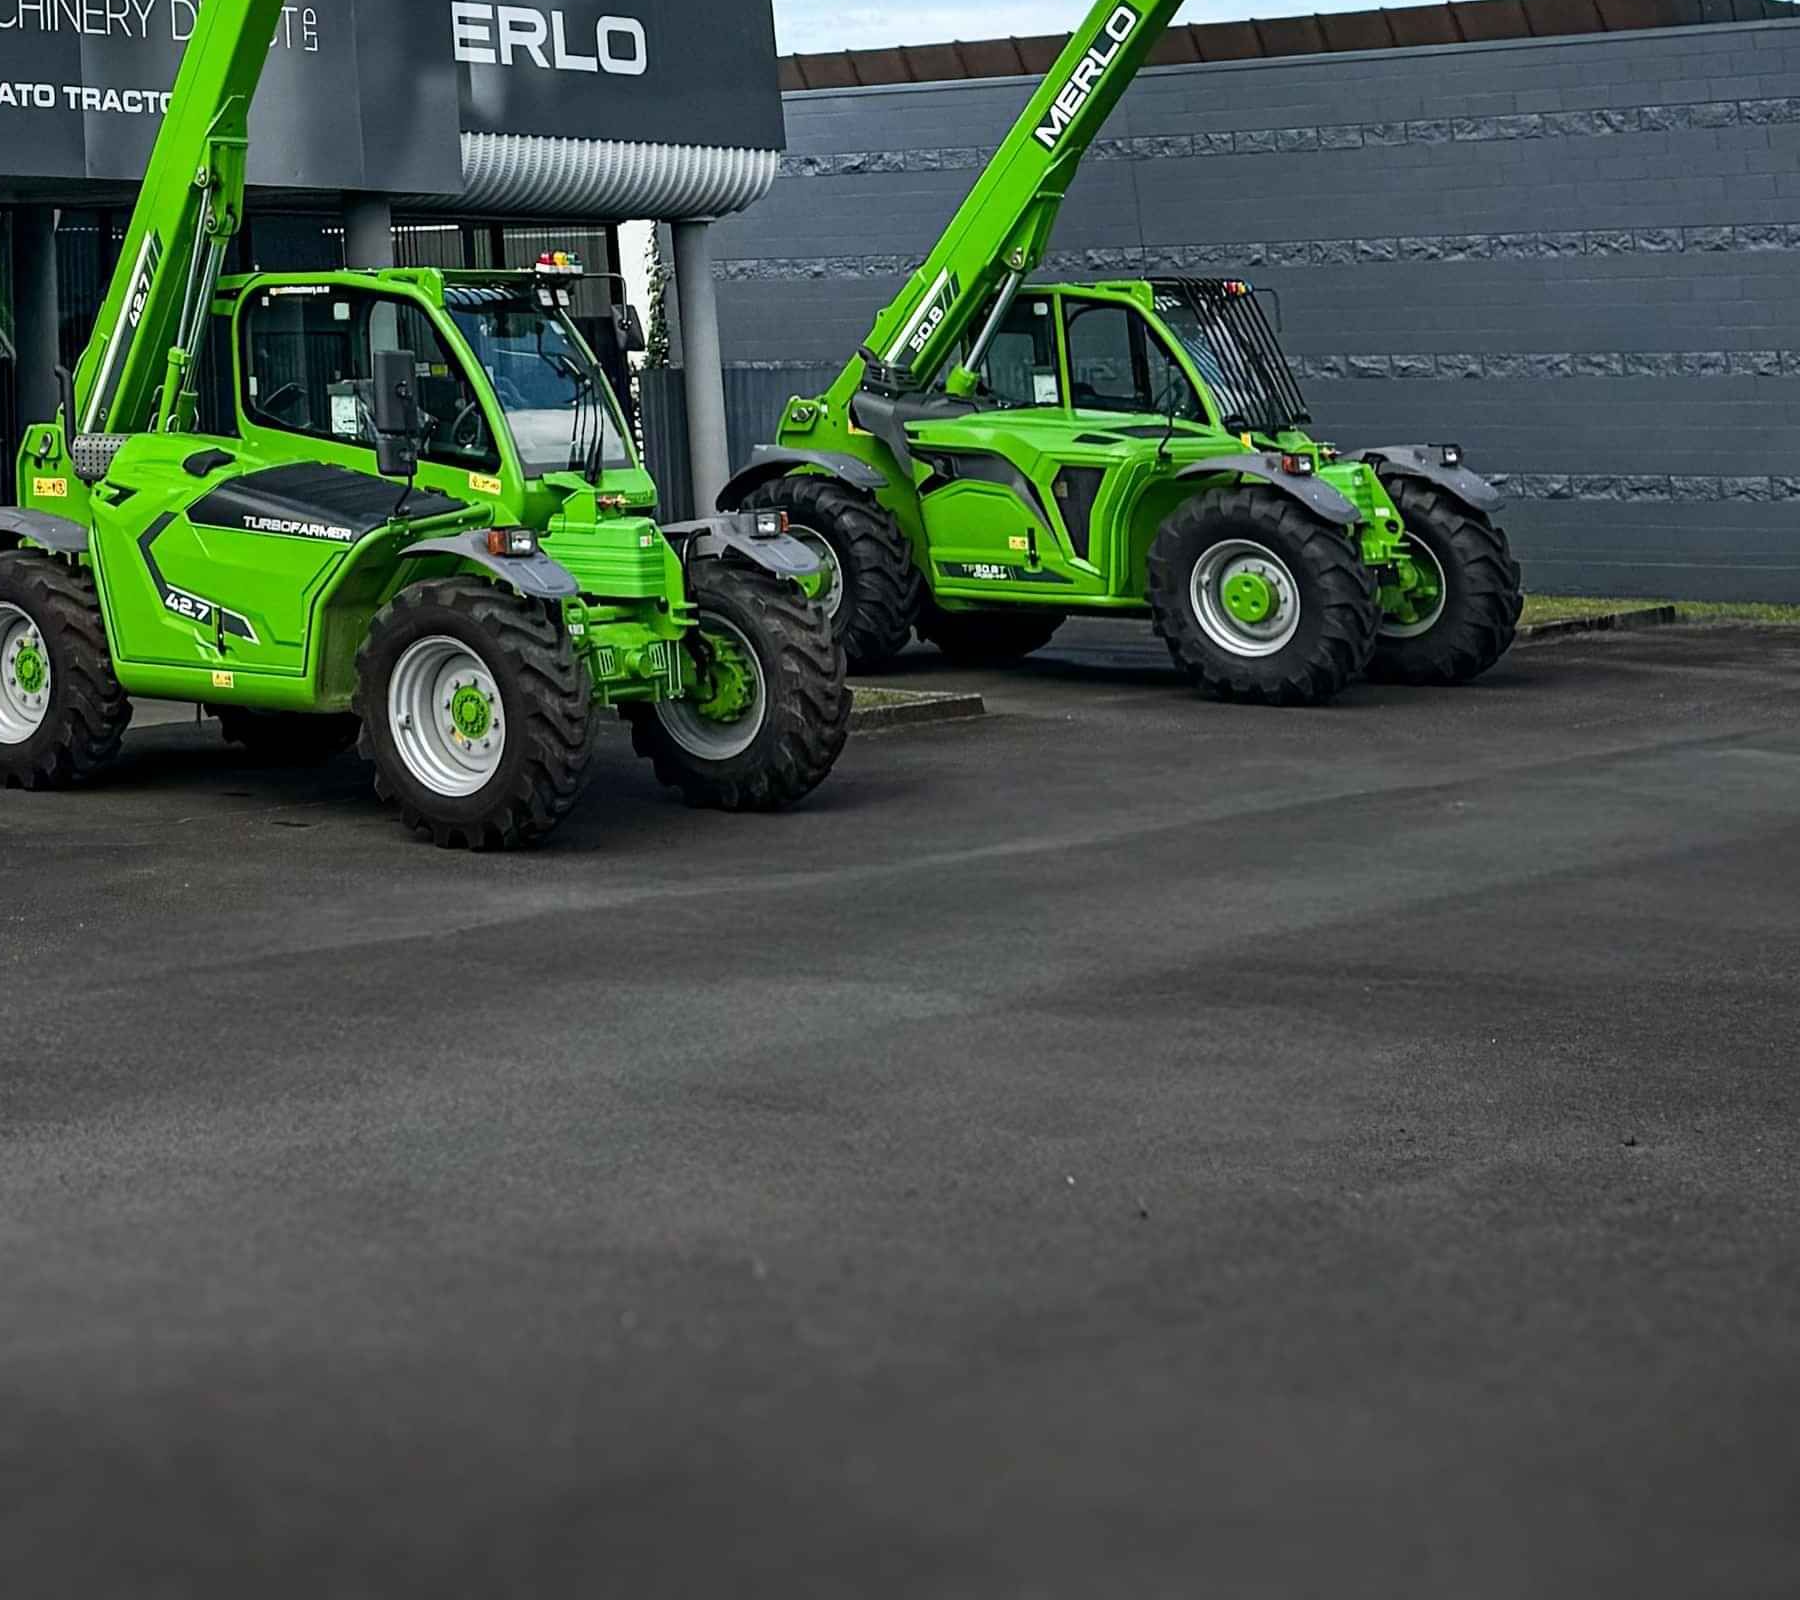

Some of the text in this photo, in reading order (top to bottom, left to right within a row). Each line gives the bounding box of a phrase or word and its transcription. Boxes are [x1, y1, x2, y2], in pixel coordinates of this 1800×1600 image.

[303, 7, 319, 52] LTD
[451, 0, 647, 76] ERLO
[1034, 5, 1137, 148] MERLO
[909, 305, 944, 353] 50.8
[243, 514, 353, 541] TURBOFARMER
[164, 592, 210, 621] 42.7
